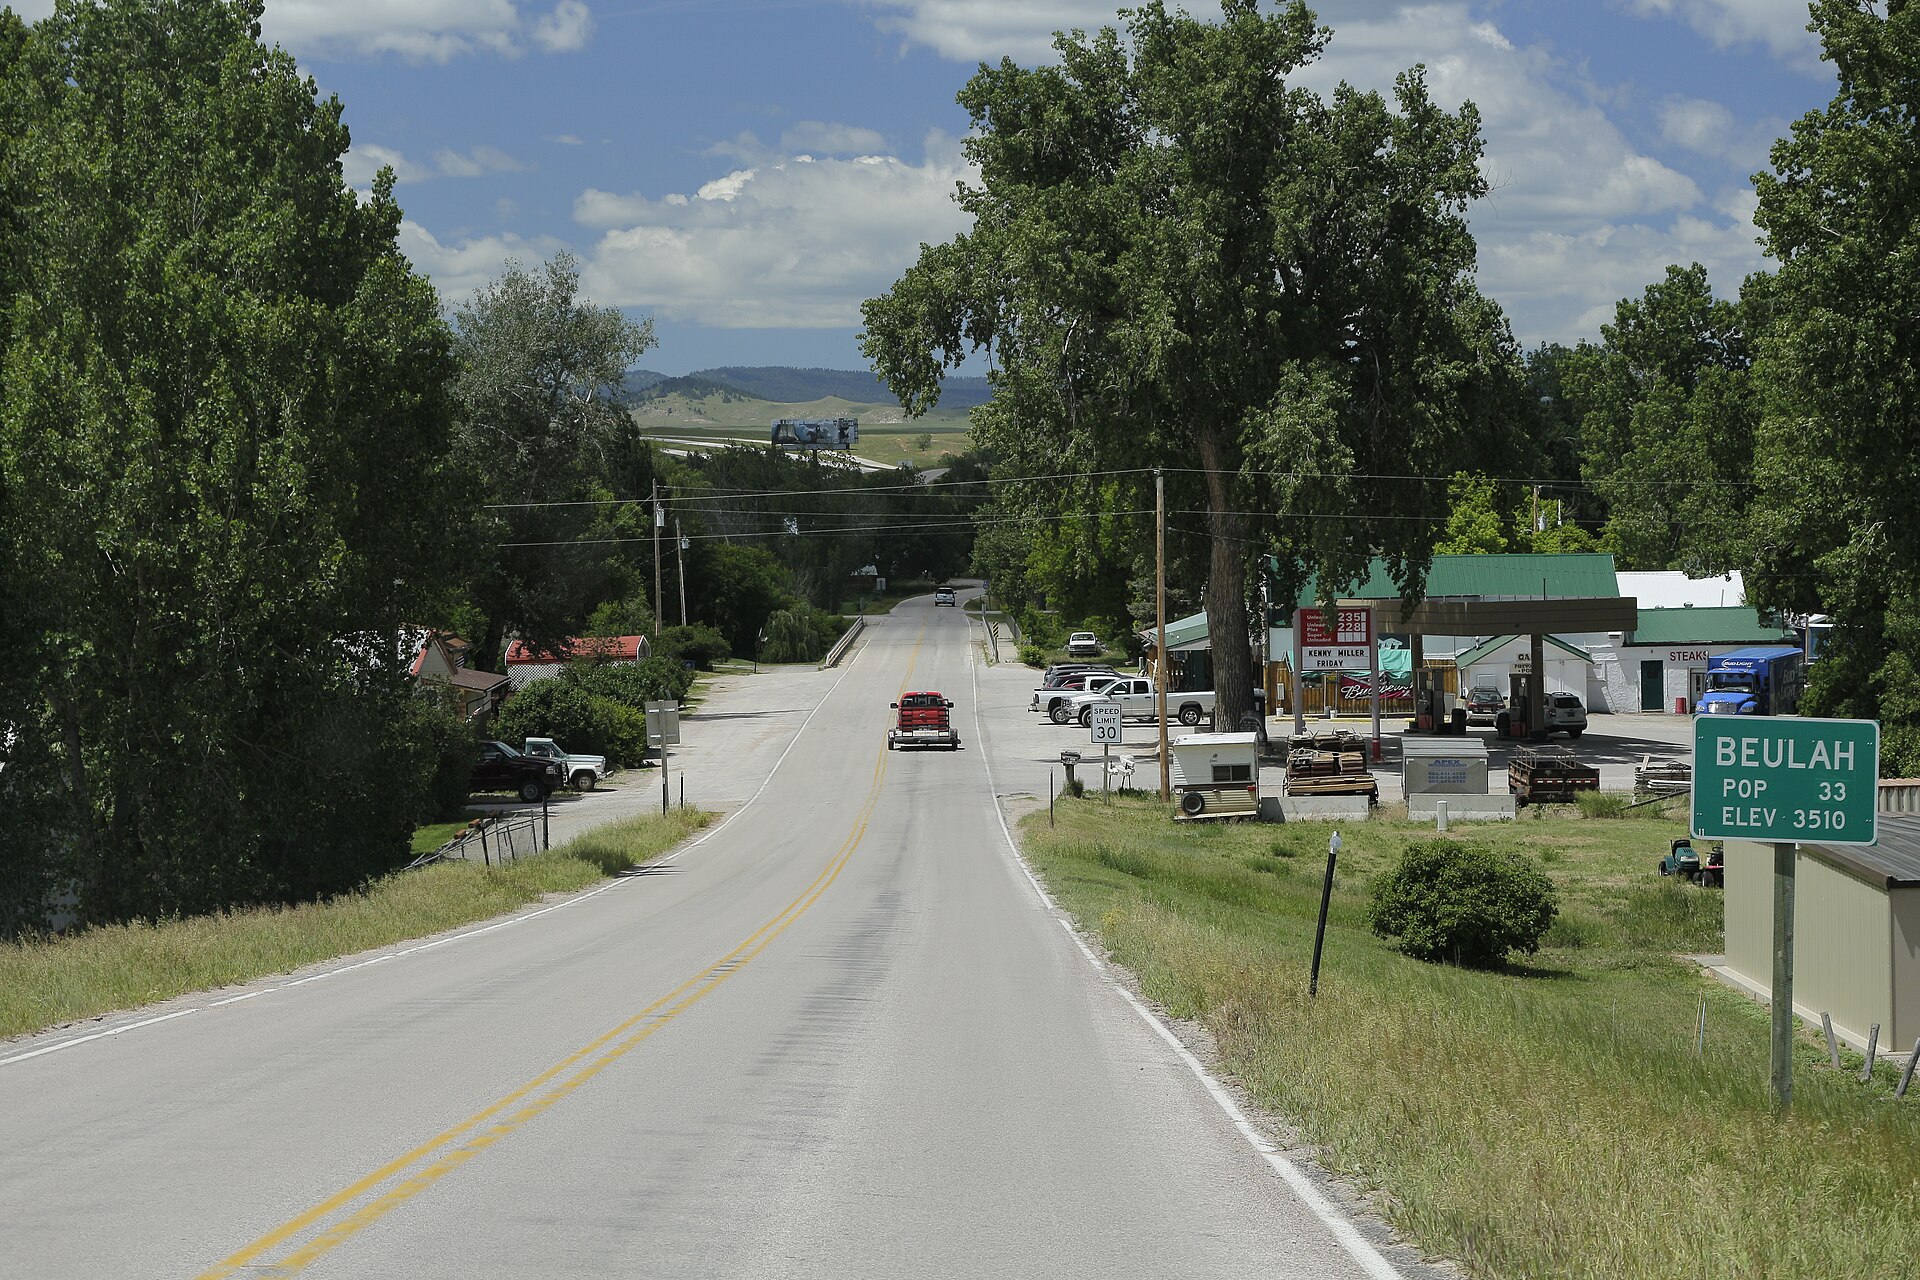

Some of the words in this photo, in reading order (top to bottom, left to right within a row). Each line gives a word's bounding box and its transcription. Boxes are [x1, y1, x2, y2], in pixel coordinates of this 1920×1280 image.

[1338, 612, 1361, 621] 235
[1338, 623, 1361, 631] 228
[1669, 651, 1707, 661] STEAKS
[1097, 726, 1116, 739] 30
[1716, 736, 1855, 771] BEULAH
[1723, 778, 1767, 798] POP
[1818, 782, 1847, 801] 33
[1722, 806, 1777, 827] ELEV
[1793, 809, 1846, 830] 3510
